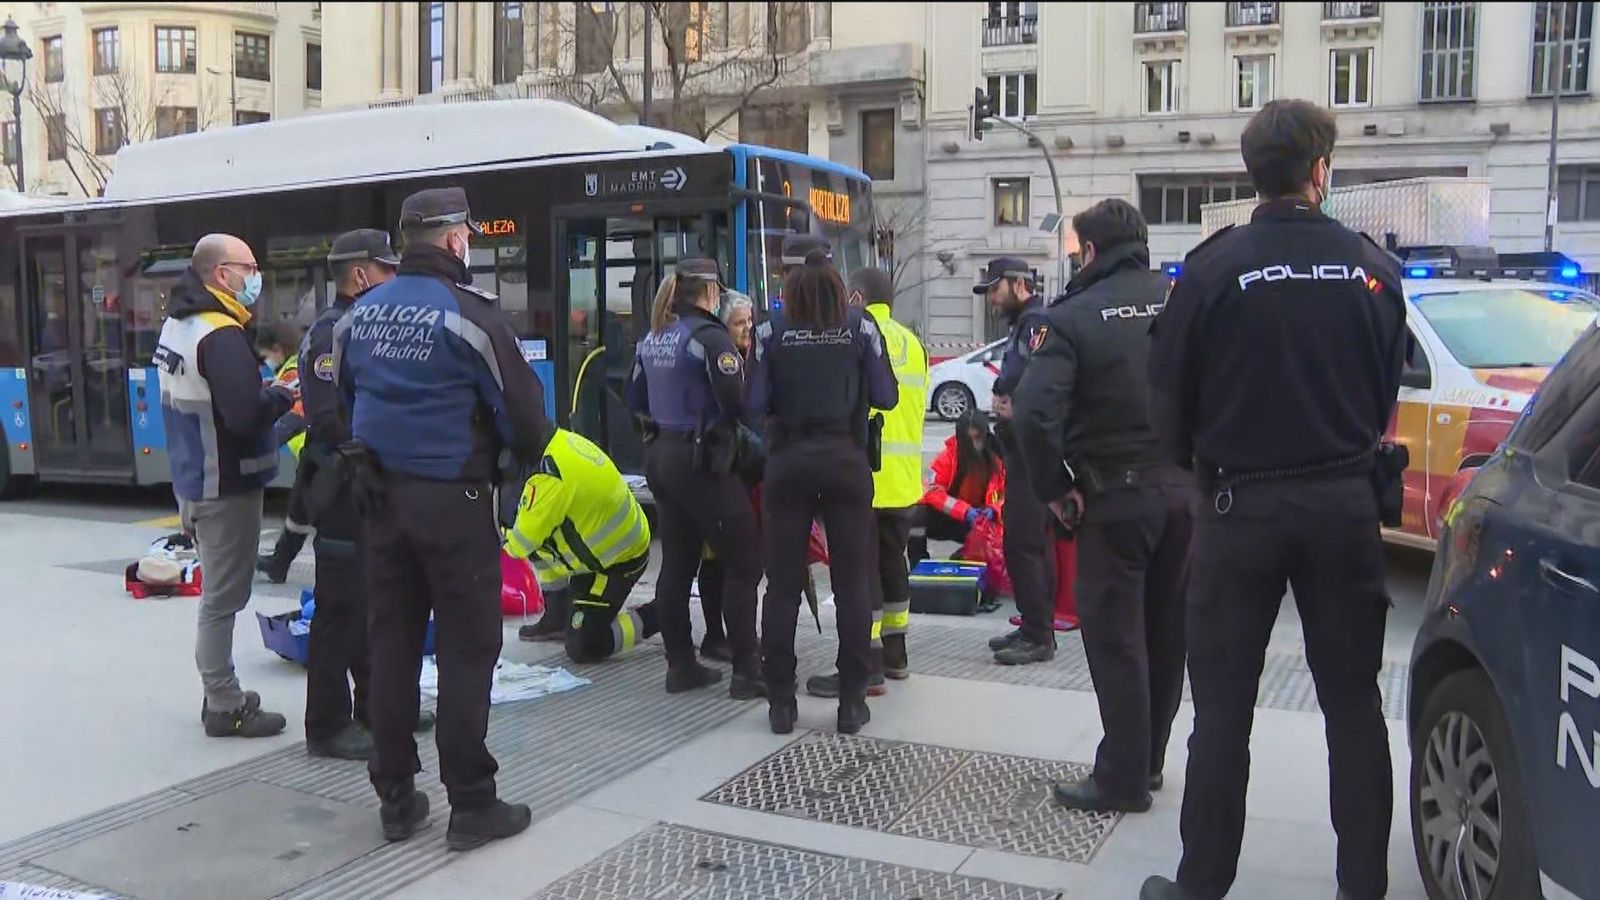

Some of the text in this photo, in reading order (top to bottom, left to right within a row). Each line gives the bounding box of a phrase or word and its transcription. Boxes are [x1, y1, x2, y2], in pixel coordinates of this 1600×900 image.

[631, 171, 656, 182] EMT
[610, 181, 657, 193] MADRID
[480, 219, 515, 235] ALEZA
[1238, 264, 1368, 291] POLICIA
[352, 303, 441, 327] POLICÍA
[1101, 303, 1164, 322] POLIC
[350, 323, 434, 343] MUNICIPAL
[371, 341, 433, 361] Madrid
[1560, 643, 1600, 703] P
[1556, 711, 1600, 789] N
